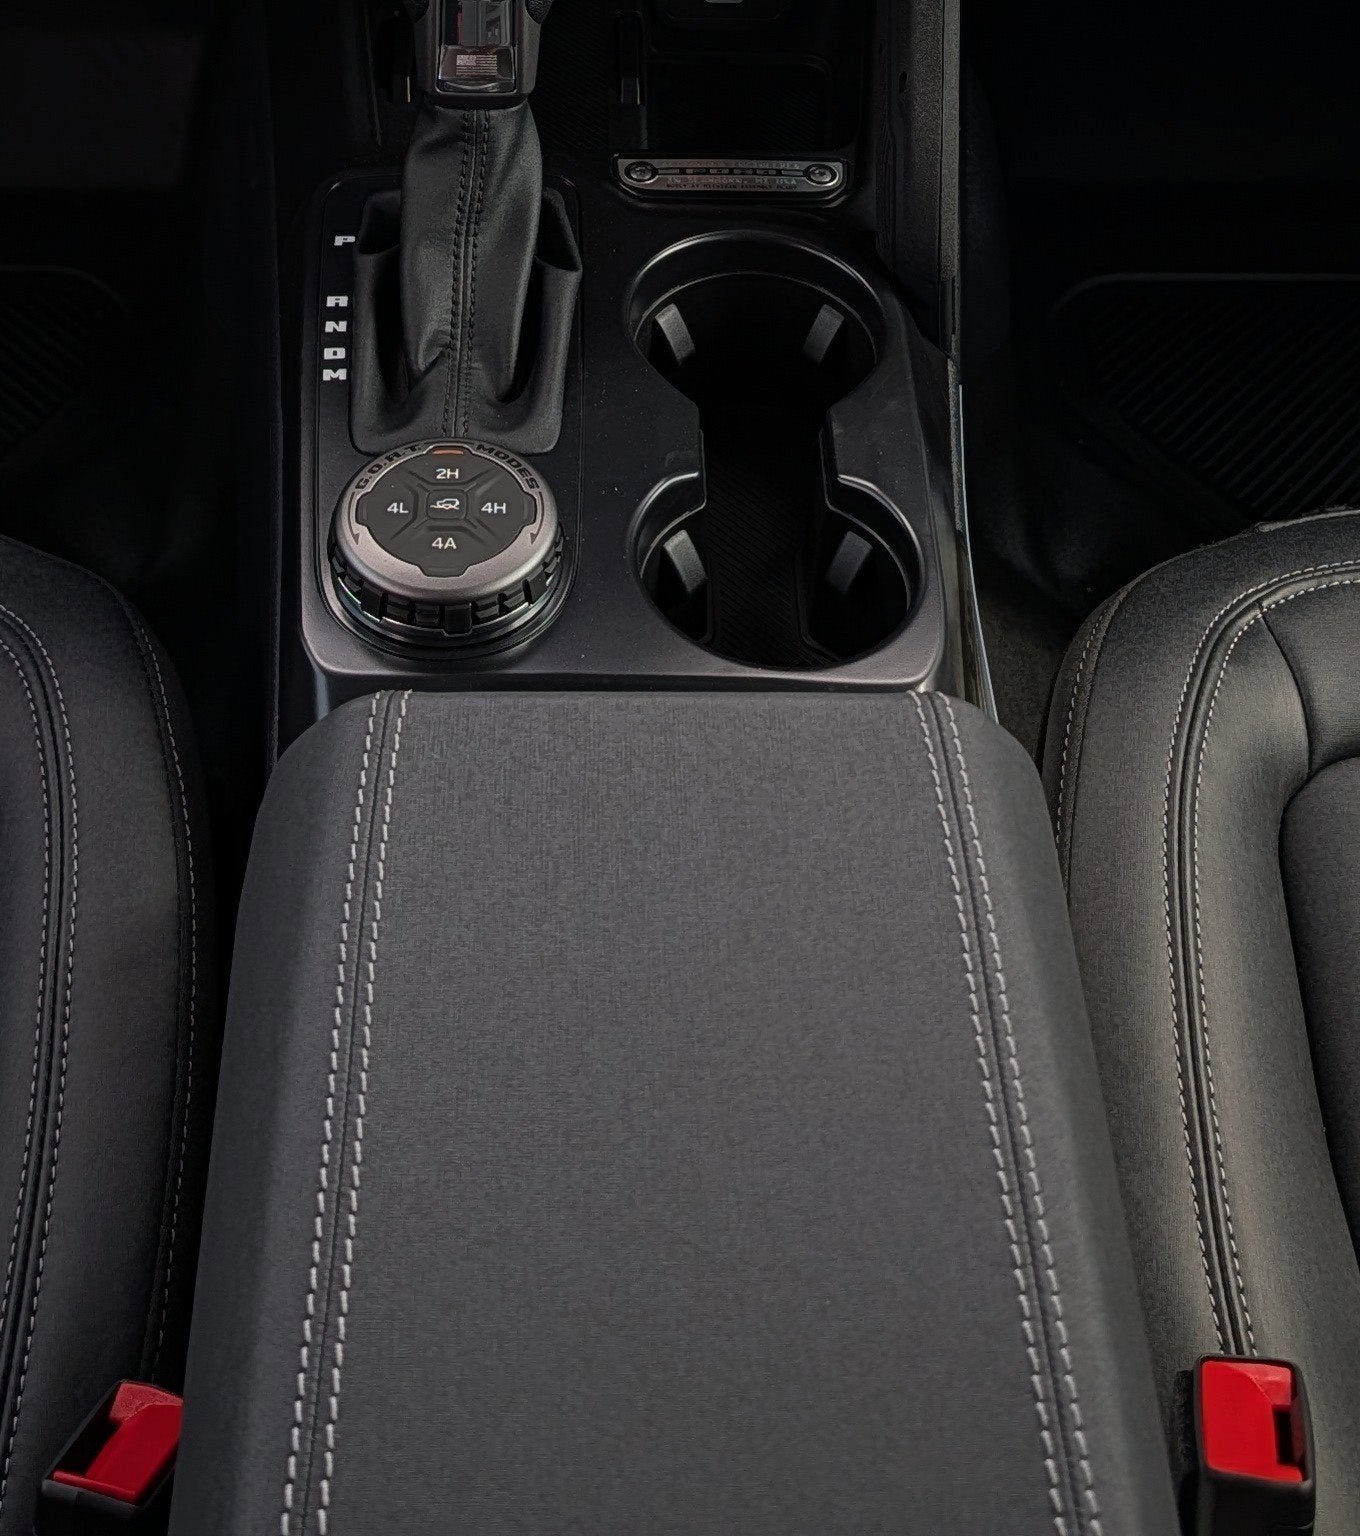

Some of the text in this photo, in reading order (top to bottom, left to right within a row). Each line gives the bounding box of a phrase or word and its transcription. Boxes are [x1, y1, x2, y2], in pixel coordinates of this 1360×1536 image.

[334, 235, 356, 246] P
[325, 320, 347, 332] N
[324, 347, 346, 360] D
[322, 368, 347, 381] M
[476, 444, 540, 489] MODES
[436, 468, 459, 479] 2H
[387, 502, 409, 514] 4L
[481, 502, 507, 514] 4H
[431, 537, 457, 550] 4A
